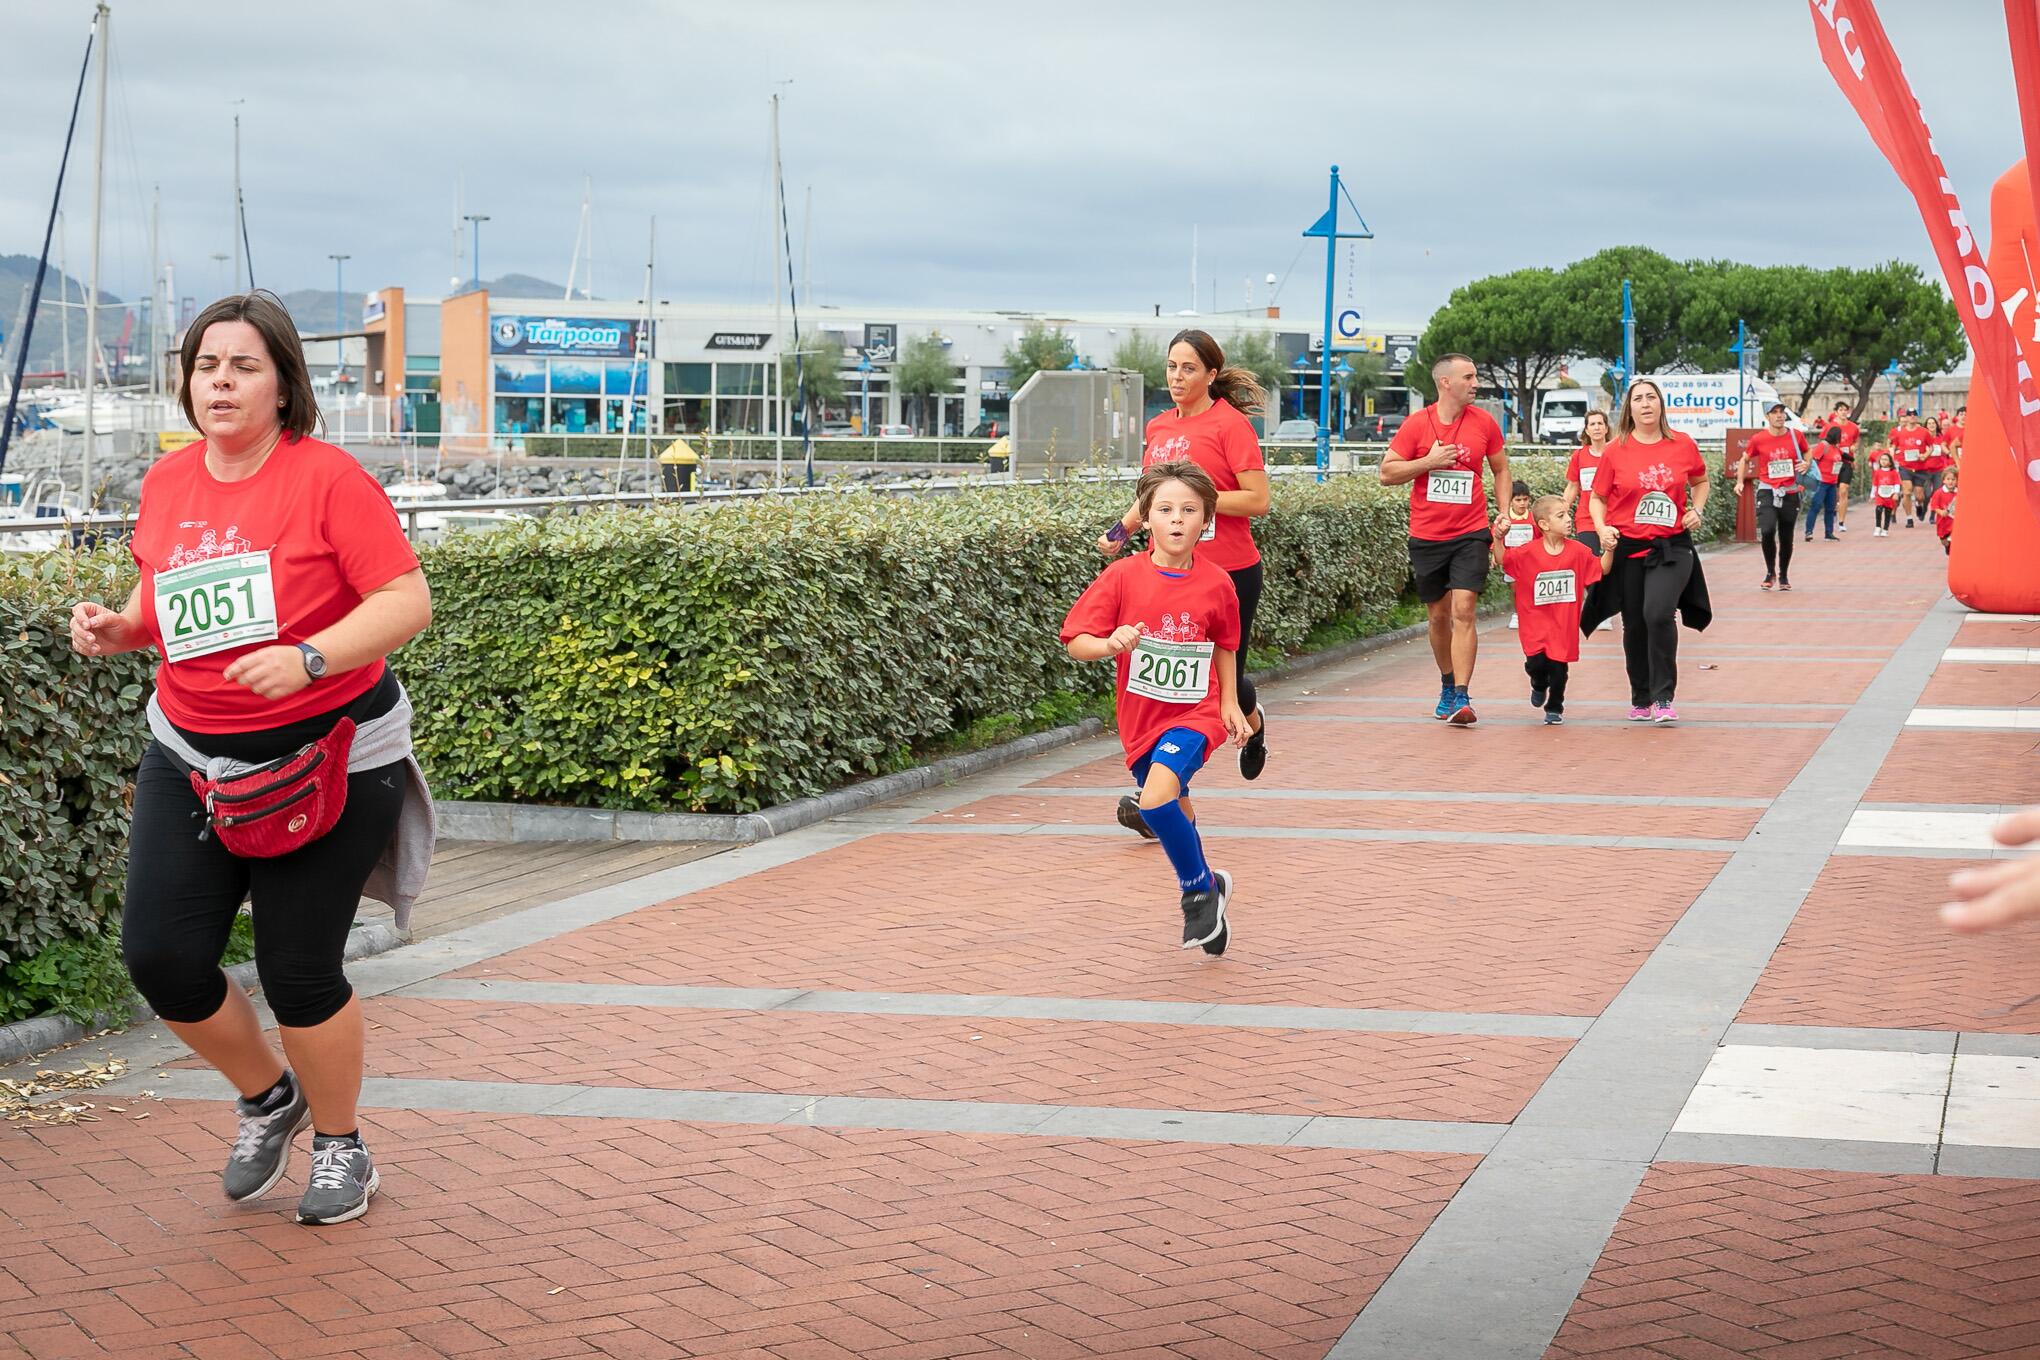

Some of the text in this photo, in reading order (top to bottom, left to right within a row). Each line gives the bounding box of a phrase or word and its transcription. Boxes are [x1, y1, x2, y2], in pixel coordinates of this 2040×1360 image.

[1338, 310, 1361, 337] C
[527, 322, 620, 347] Tarpoon
[1745, 384, 1756, 395] A
[1667, 393, 1739, 410] lefurgo
[1433, 478, 1467, 495] 2041
[1639, 500, 1673, 518] 2041
[1539, 580, 1569, 596] 2041
[168, 578, 255, 637] 2051
[1138, 653, 1200, 688] 2061
